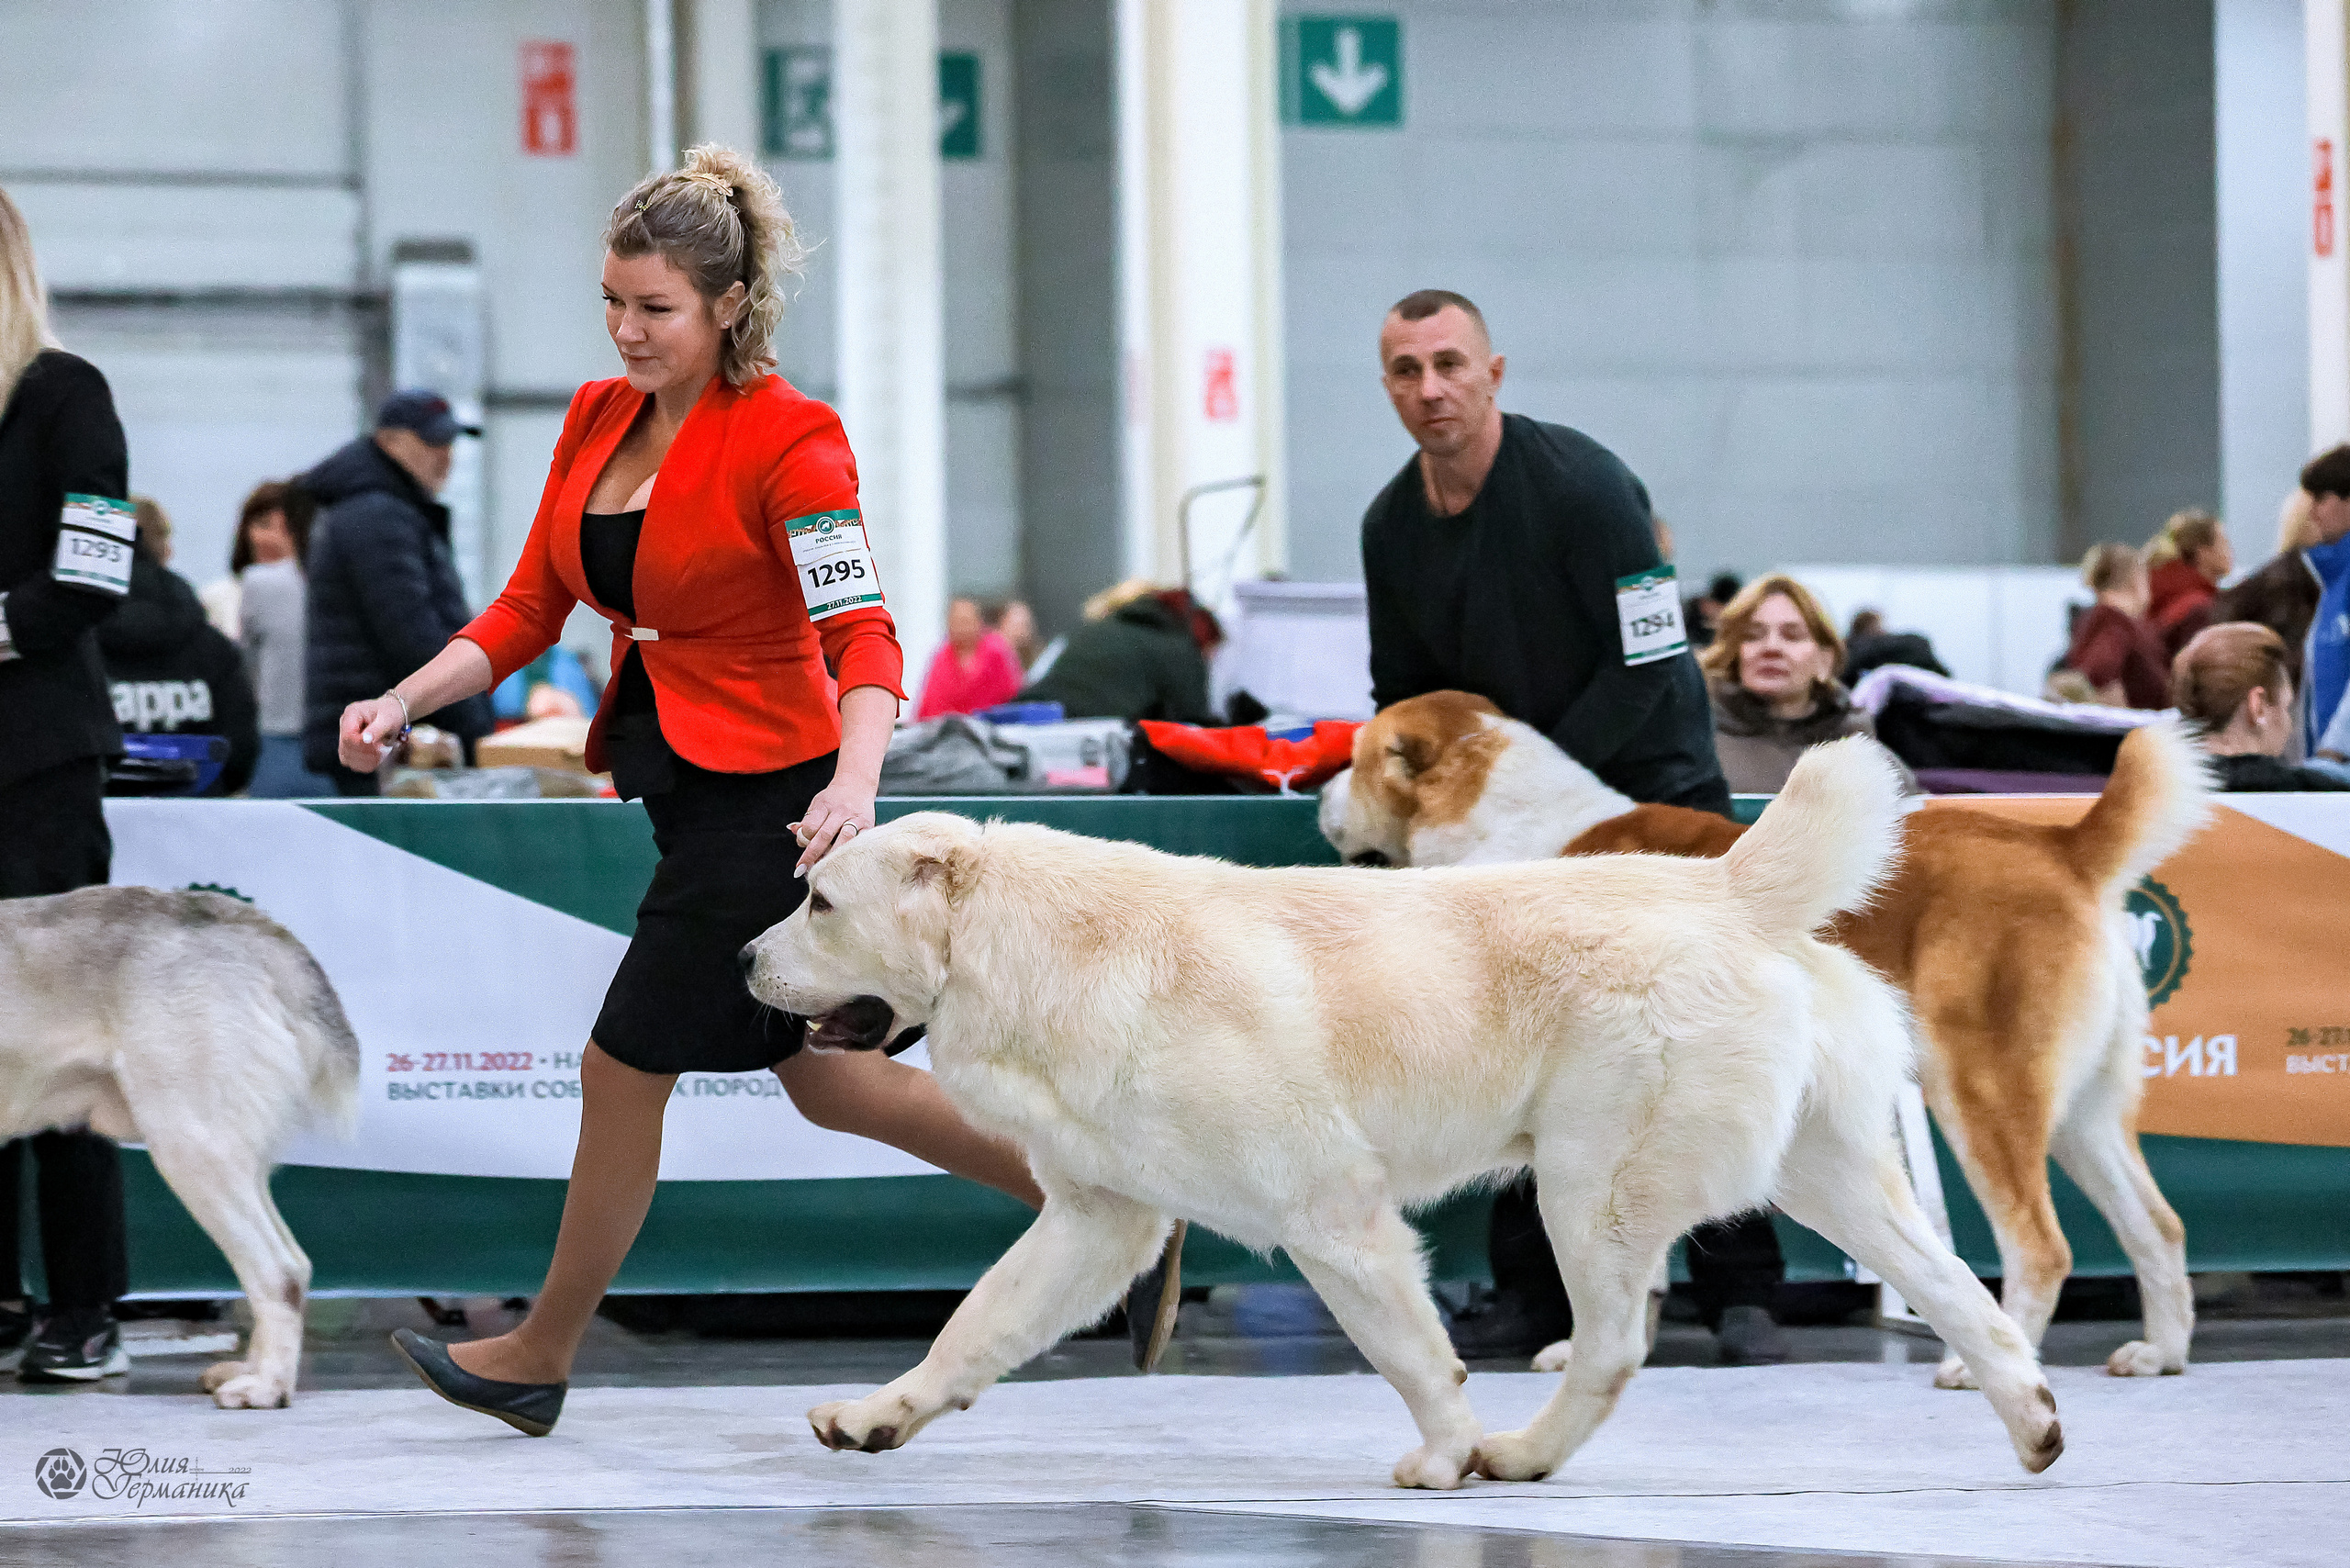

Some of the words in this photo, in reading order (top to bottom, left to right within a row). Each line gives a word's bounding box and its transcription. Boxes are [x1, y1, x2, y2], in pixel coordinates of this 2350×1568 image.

[815, 533, 843, 544] РОССИЯ
[807, 558, 866, 588] 1295
[827, 595, 863, 610] 27.11.2022
[108, 678, 212, 731] appa
[386, 1052, 533, 1072] 26-27.11.2022
[2142, 1034, 2238, 1078] СИЯ
[2286, 1054, 2350, 1074] ВЫСТ
[386, 1081, 525, 1100] ВЫСТАВКИ
[531, 1080, 583, 1099] СОБ
[694, 1077, 782, 1097] ПОРОД
